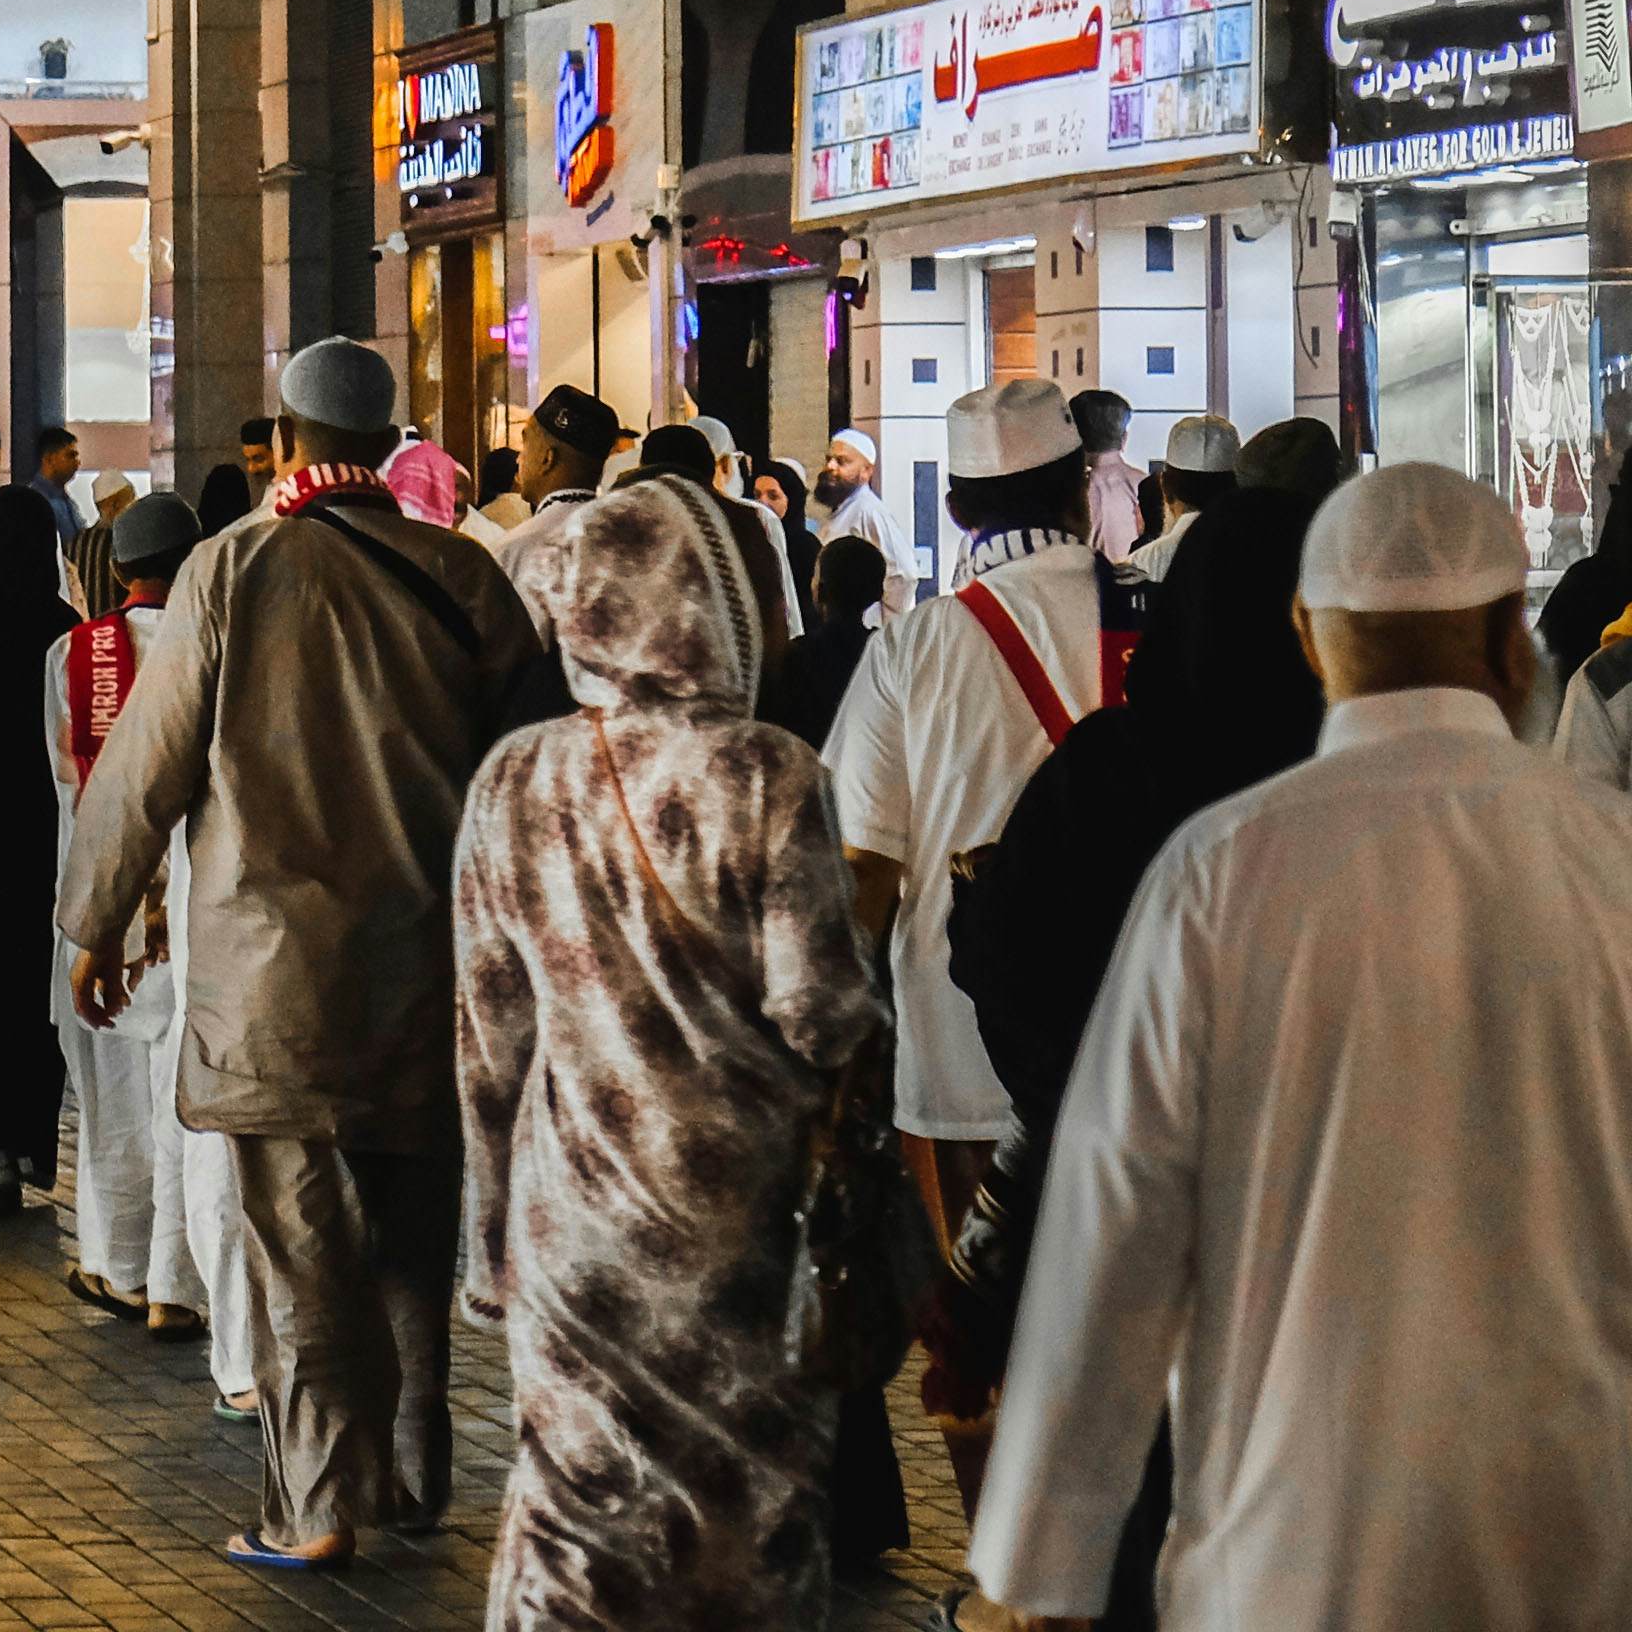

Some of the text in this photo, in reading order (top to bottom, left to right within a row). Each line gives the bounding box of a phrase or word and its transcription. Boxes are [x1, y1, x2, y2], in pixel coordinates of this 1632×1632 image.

[933, 4, 1104, 122] صراف
[1441, 130, 1470, 166] FOR
[1471, 124, 1507, 161] GOLD
